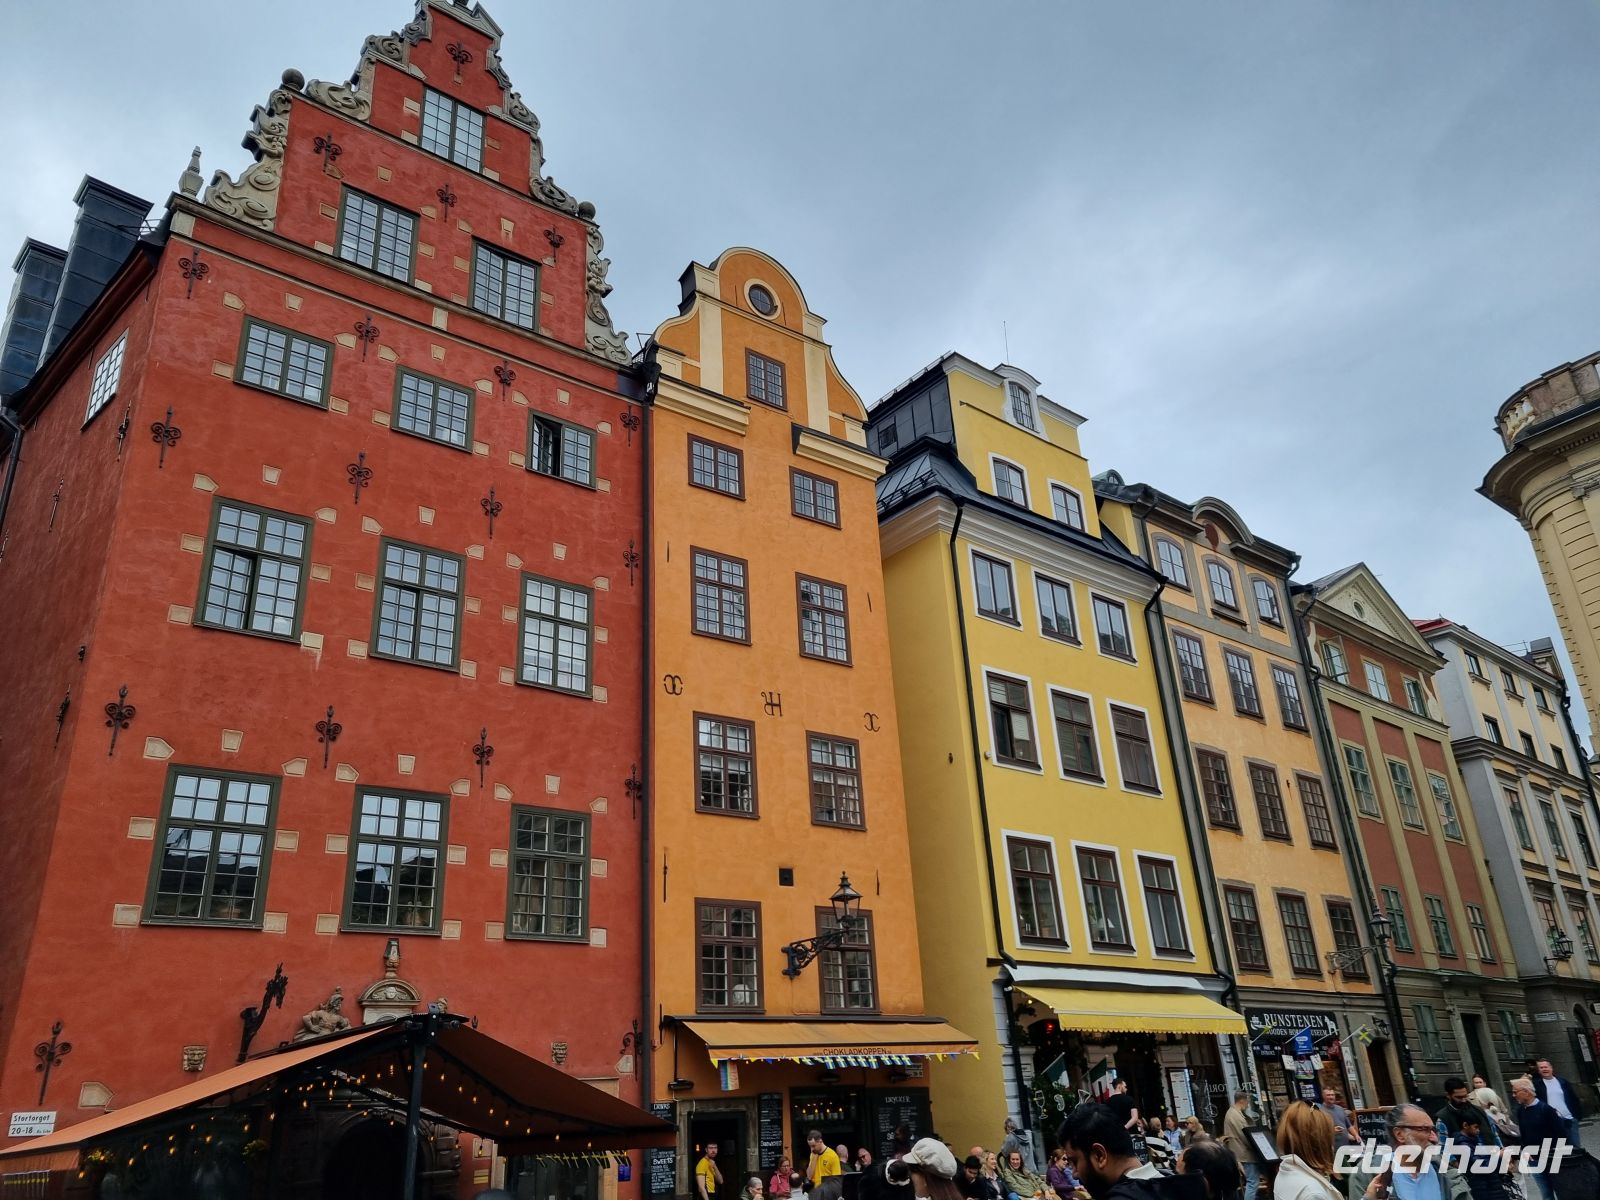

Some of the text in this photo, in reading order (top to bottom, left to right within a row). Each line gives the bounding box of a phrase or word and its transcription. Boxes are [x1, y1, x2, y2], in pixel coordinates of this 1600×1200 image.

[1263, 1013, 1324, 1027] RUNSTENEN
[14, 1114, 50, 1122] Stortorget
[11, 1126, 33, 1134] 20-18
